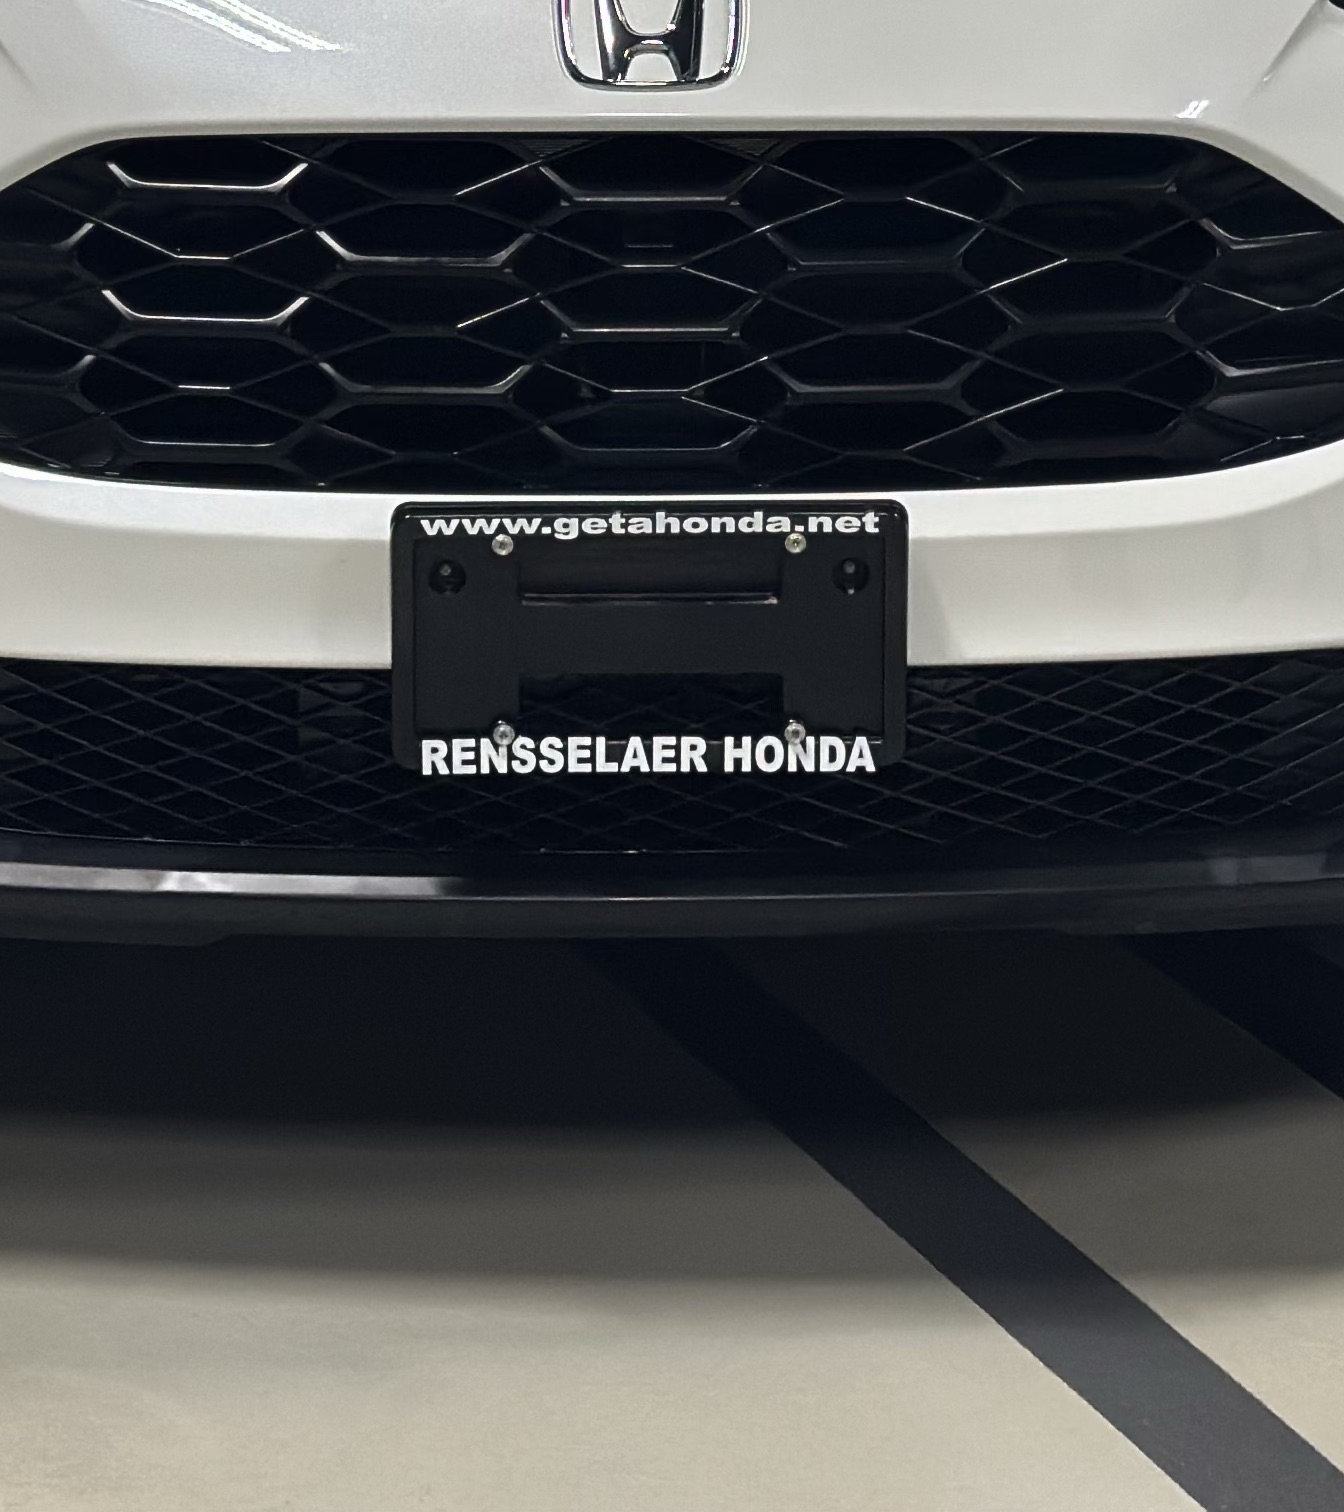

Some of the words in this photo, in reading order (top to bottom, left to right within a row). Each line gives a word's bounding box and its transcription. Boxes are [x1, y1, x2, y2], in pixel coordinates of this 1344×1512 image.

[420, 511, 880, 540] www.getahonda.net
[421, 735, 708, 776] RENSSELAER
[723, 735, 876, 774] HONDA
